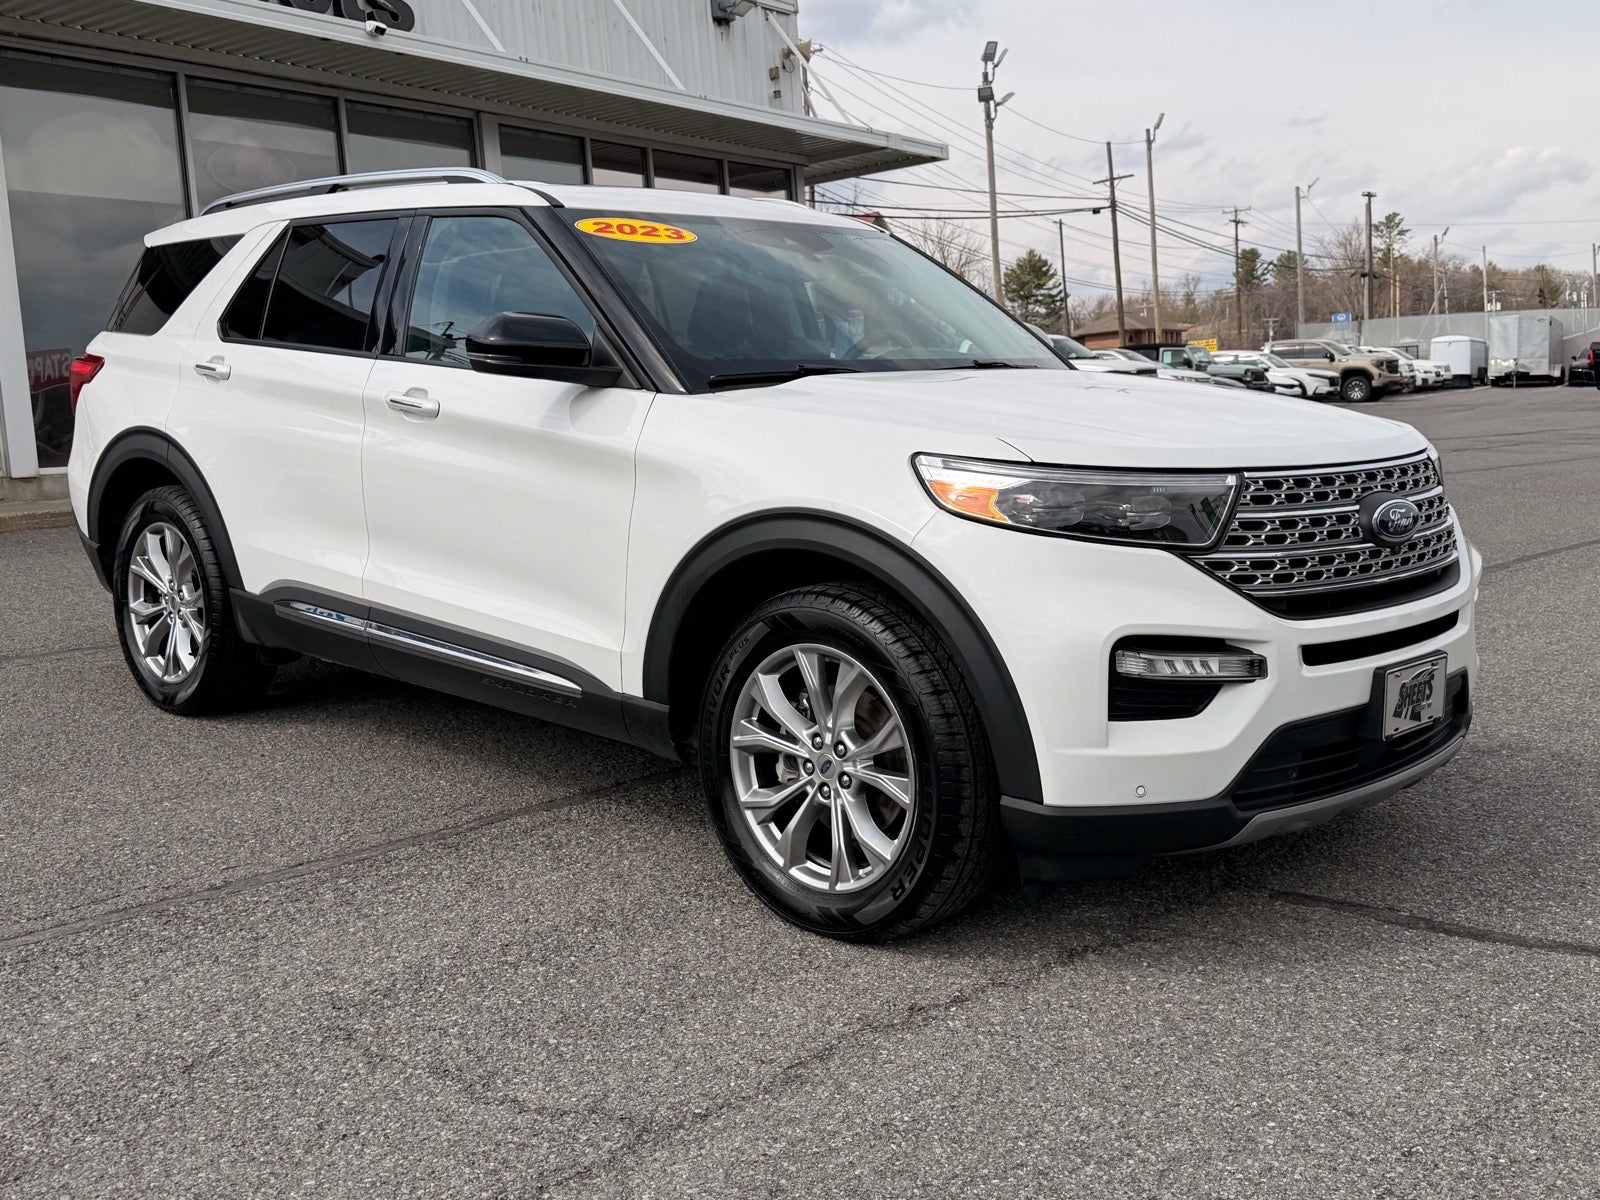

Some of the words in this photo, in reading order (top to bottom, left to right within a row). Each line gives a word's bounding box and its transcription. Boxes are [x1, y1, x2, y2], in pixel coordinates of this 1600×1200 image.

[592, 221, 687, 241] 2023
[1388, 507, 1413, 532] Ford
[729, 636, 750, 660] PLUS
[1397, 673, 1435, 711] SHEETS
